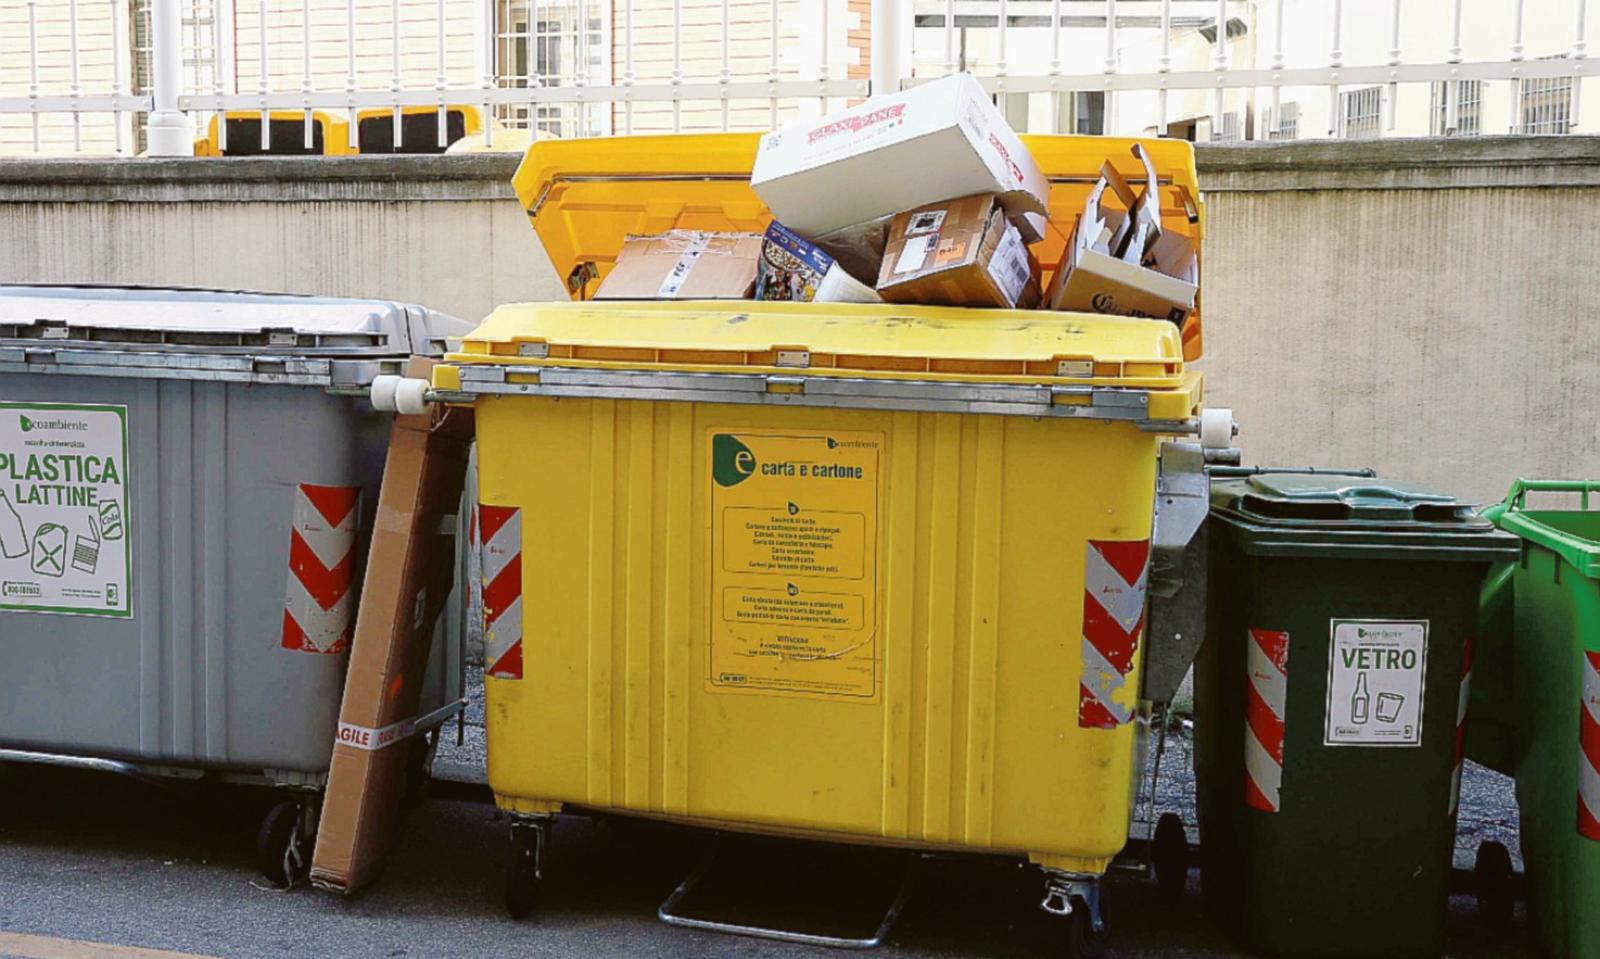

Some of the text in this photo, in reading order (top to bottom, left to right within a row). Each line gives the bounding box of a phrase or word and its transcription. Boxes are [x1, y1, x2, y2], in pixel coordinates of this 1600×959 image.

[761, 462, 863, 479] carta e cartone
[15, 483, 100, 508] LATTINE
[1340, 647, 1417, 670] VETRO
